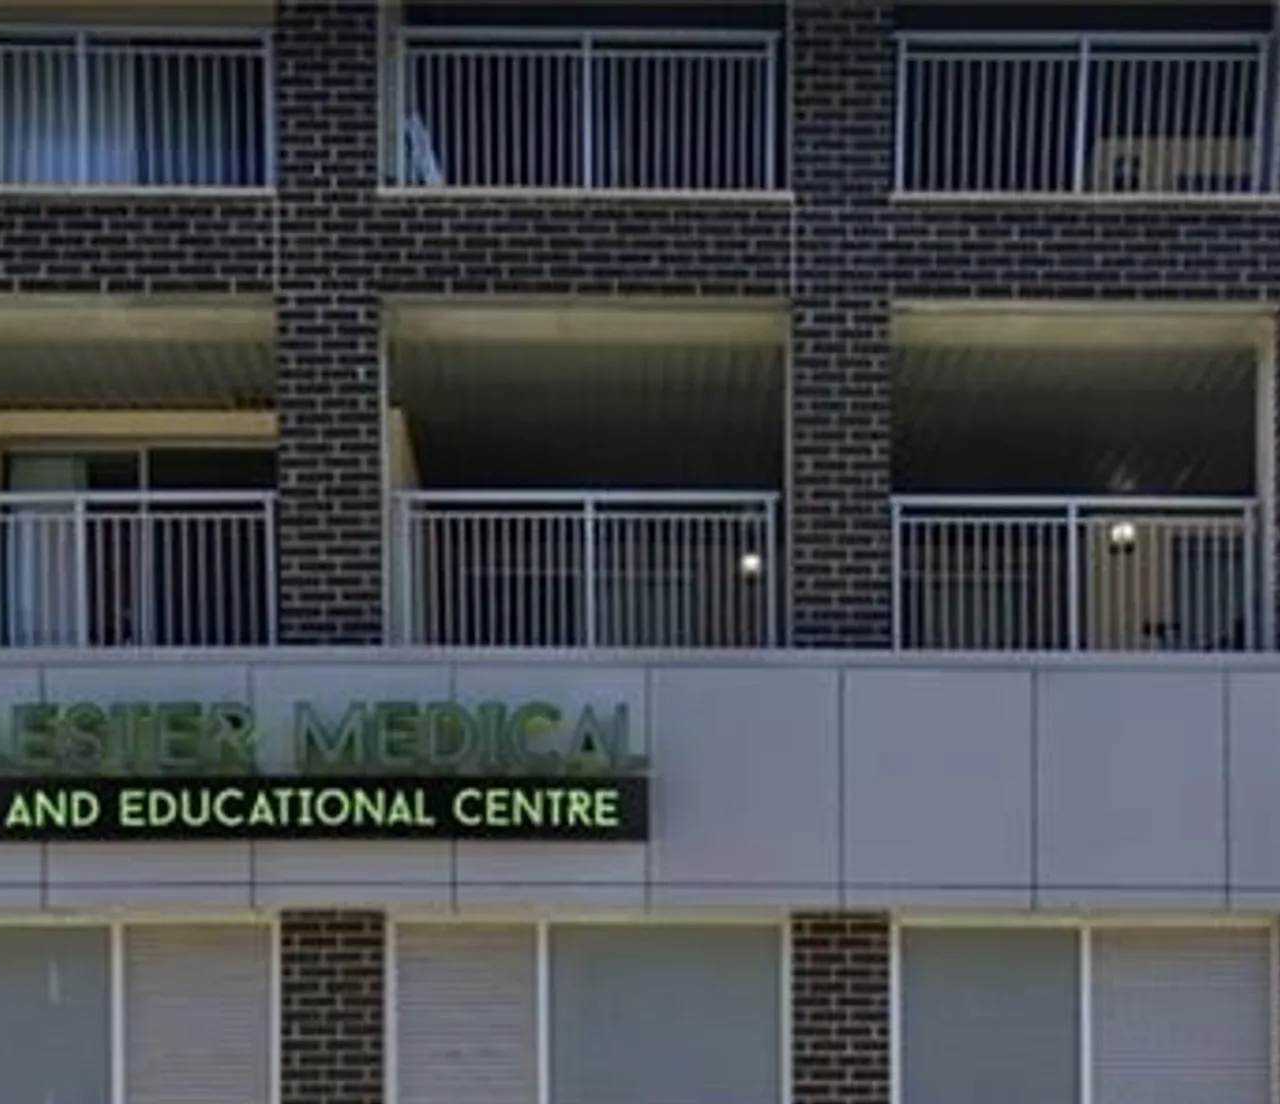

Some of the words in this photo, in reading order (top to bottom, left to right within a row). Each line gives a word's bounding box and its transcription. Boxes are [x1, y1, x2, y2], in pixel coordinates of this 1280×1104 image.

[295, 702, 650, 770] MEDICAL
[5, 790, 100, 828] AND
[121, 788, 436, 827] EDUCATIONAL
[453, 789, 619, 826] CENTRE
